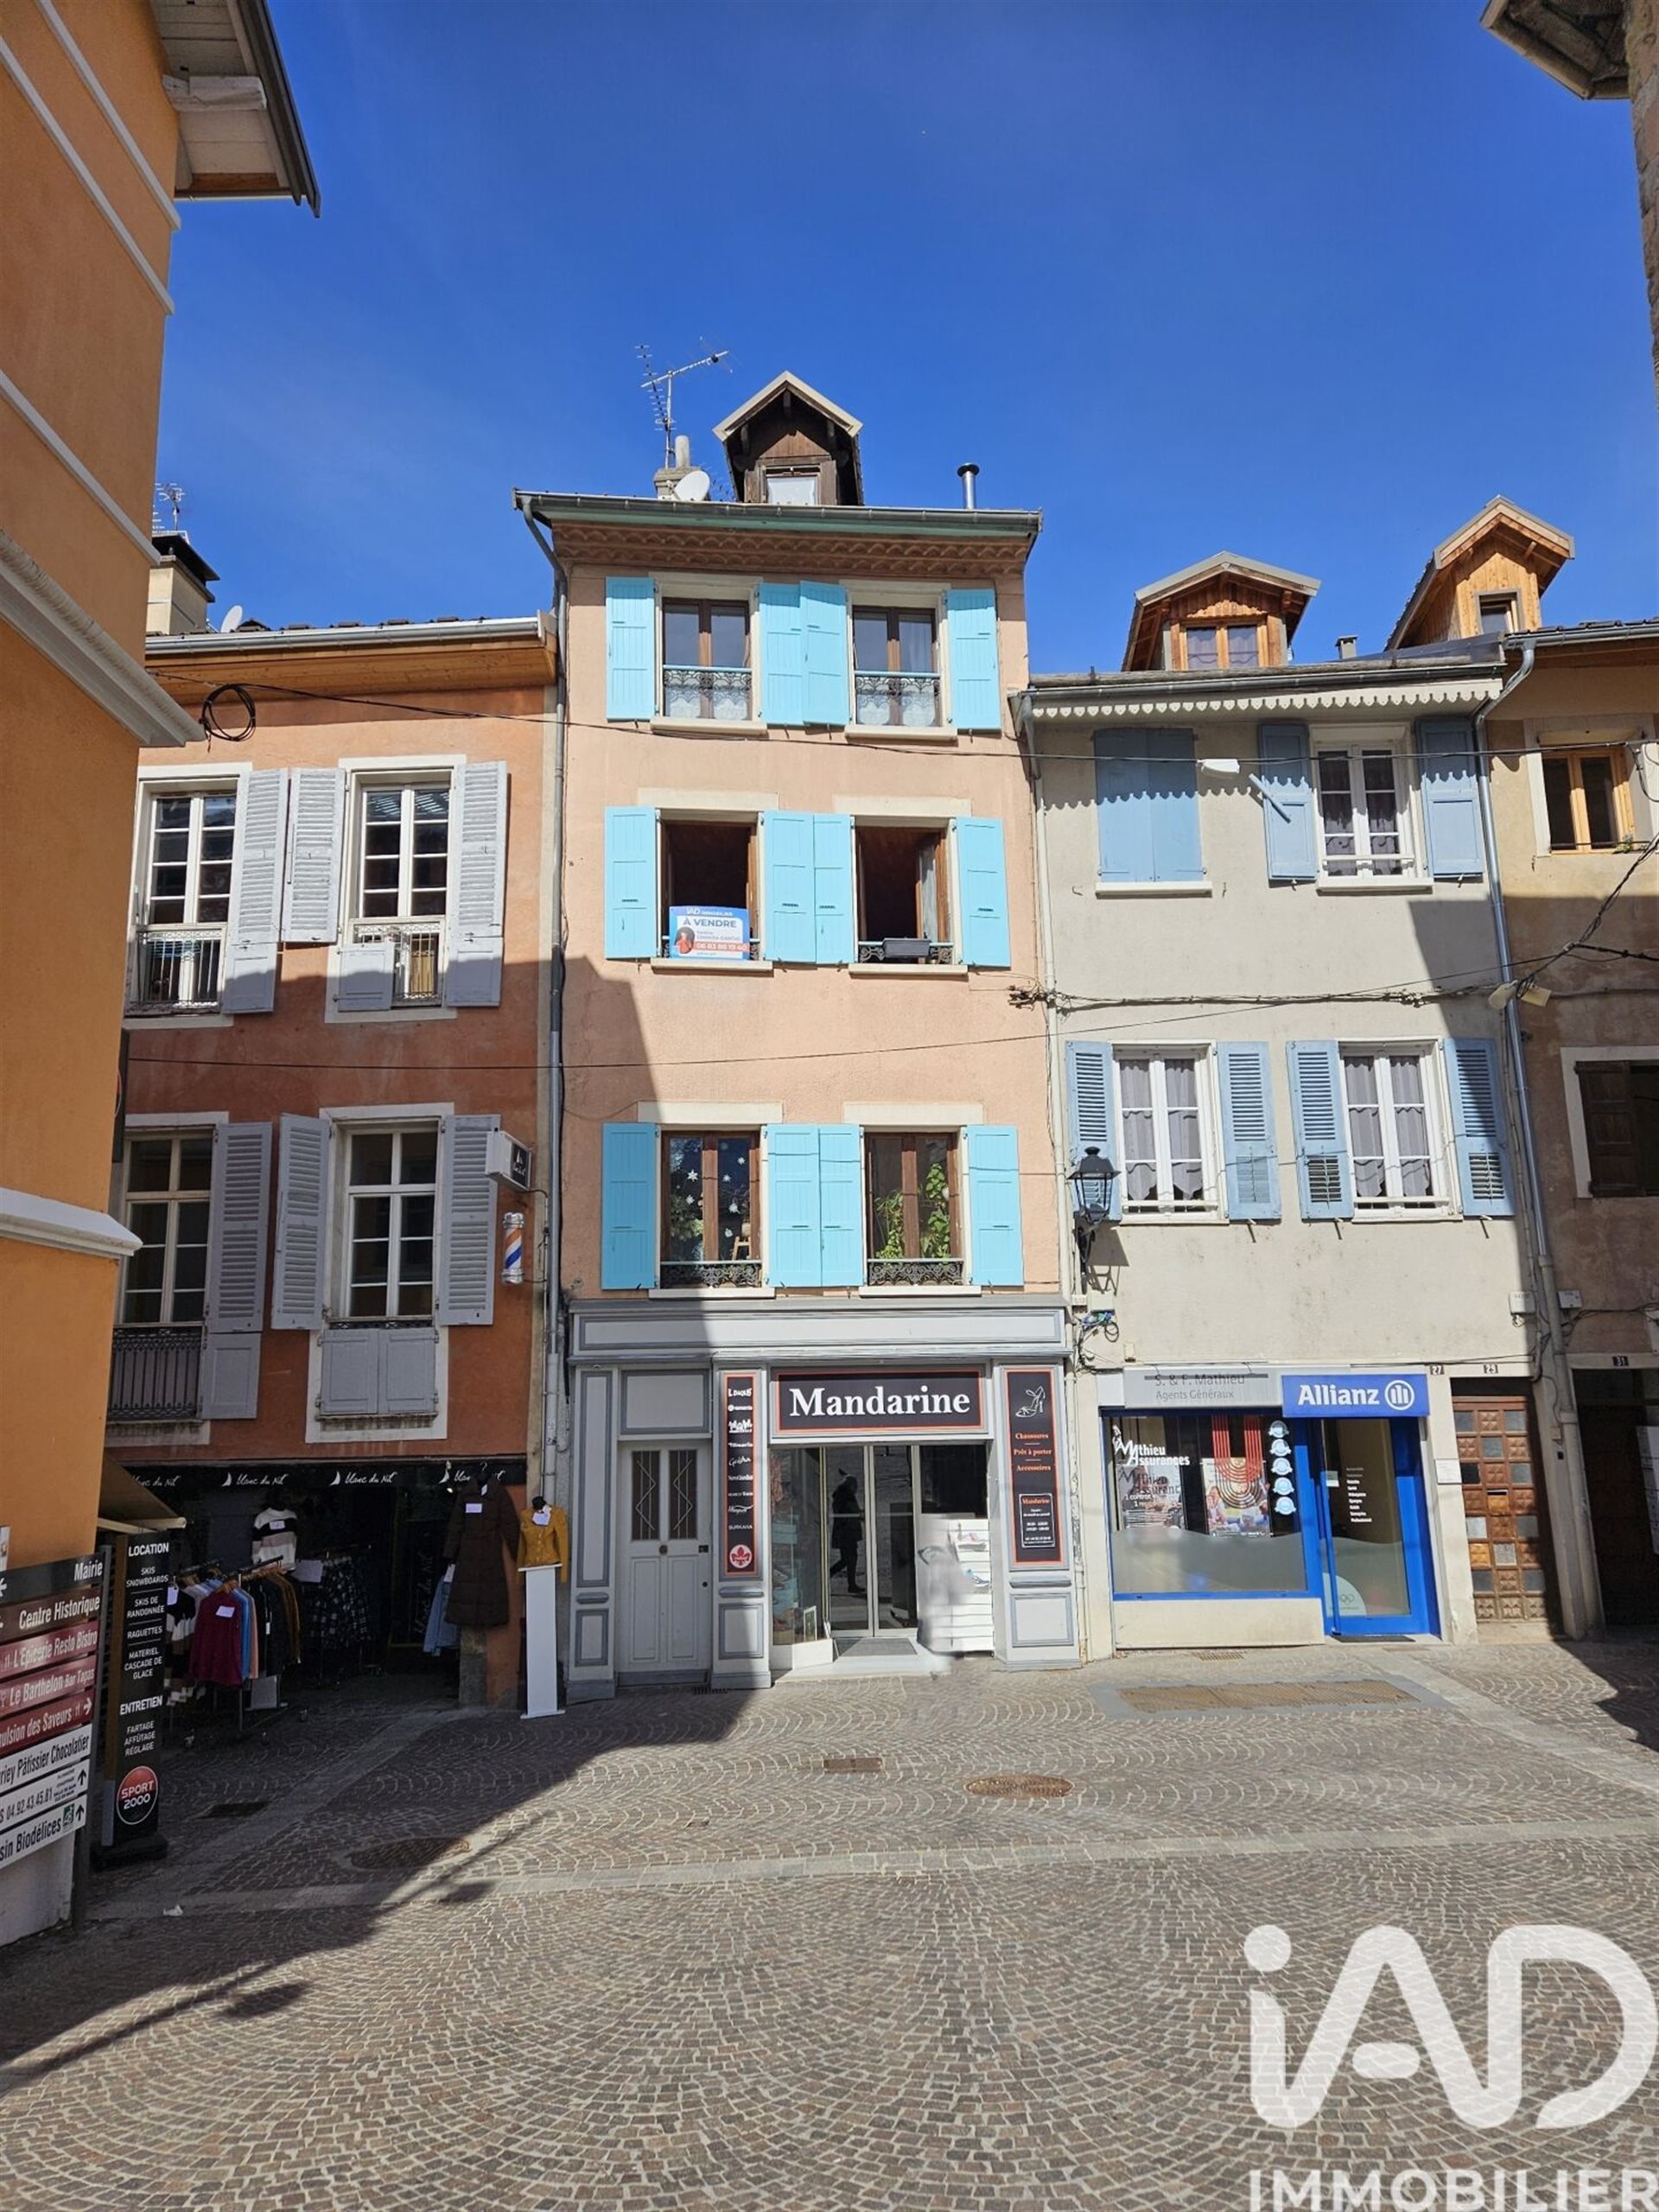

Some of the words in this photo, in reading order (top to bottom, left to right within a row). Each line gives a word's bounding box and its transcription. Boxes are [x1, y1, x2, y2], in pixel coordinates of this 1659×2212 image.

[694, 918, 737, 927] VENDRE
[1617, 1357, 1627, 1366] 31
[1432, 1365, 1442, 1375] 27
[1195, 1374, 1245, 1386] Mathieu
[789, 1385, 970, 1417] Mandarine
[1155, 1389, 1187, 1402] Agents
[1189, 1389, 1235, 1400] Généraux
[1298, 1384, 1380, 1406] Allianz
[1127, 1446, 1191, 1466] Assurances
[128, 1541, 169, 1557] LOCATION
[73, 1560, 103, 1581] Mairie
[141, 1566, 156, 1575] SKIS
[126, 1573, 168, 1587] SNOWBOARDS
[134, 1597, 149, 1607] SKIS
[149, 1596, 159, 1605] DE
[19, 1606, 52, 1630] Centre
[54, 1596, 100, 1621] Historique
[126, 1605, 166, 1618] RANDONNÉE
[54, 1636, 75, 1656] Resto
[76, 1630, 98, 1649] Bistro
[124, 1657, 153, 1671] CASCADE
[154, 1656, 162, 1665] DE
[132, 1669, 154, 1680] GLACE
[10, 1687, 22, 1707] Le
[23, 1675, 63, 1702] Barthelon
[77, 1669, 95, 1685] Tapas
[119, 1694, 163, 1716] ENTRETIEN
[0, 1724, 25, 1747] ulsion
[27, 1718, 41, 1738] des
[42, 1707, 73, 1732] Saveurs
[126, 1720, 155, 1734] FARTAGE
[17, 1751, 49, 1777] Pâtissier
[51, 1734, 90, 1764] Chocolatier
[121, 1780, 155, 1799] SPORT
[124, 1793, 151, 1810] 2000
[16, 1816, 61, 1853] Biodélices
